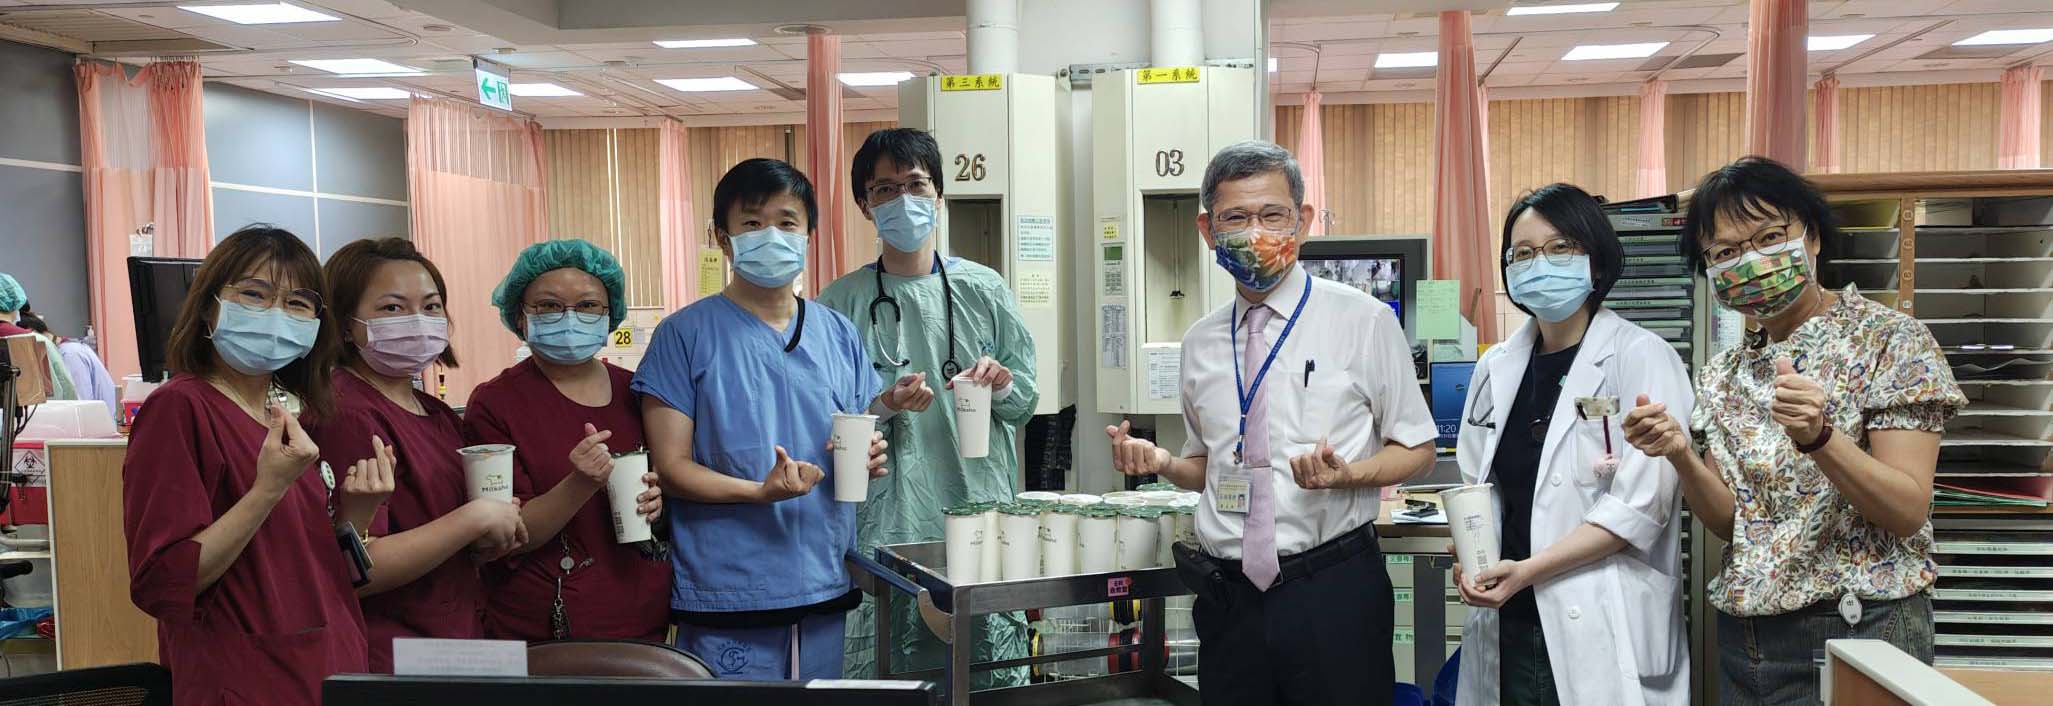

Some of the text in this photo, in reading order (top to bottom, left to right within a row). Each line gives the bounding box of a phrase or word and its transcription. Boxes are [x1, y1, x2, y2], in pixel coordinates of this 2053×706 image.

[1142, 69, 1198, 81] 第一系統
[945, 76, 1000, 89] 第三系統
[954, 153, 986, 182] 26
[1155, 149, 1185, 177] 03
[615, 331, 631, 345] 28
